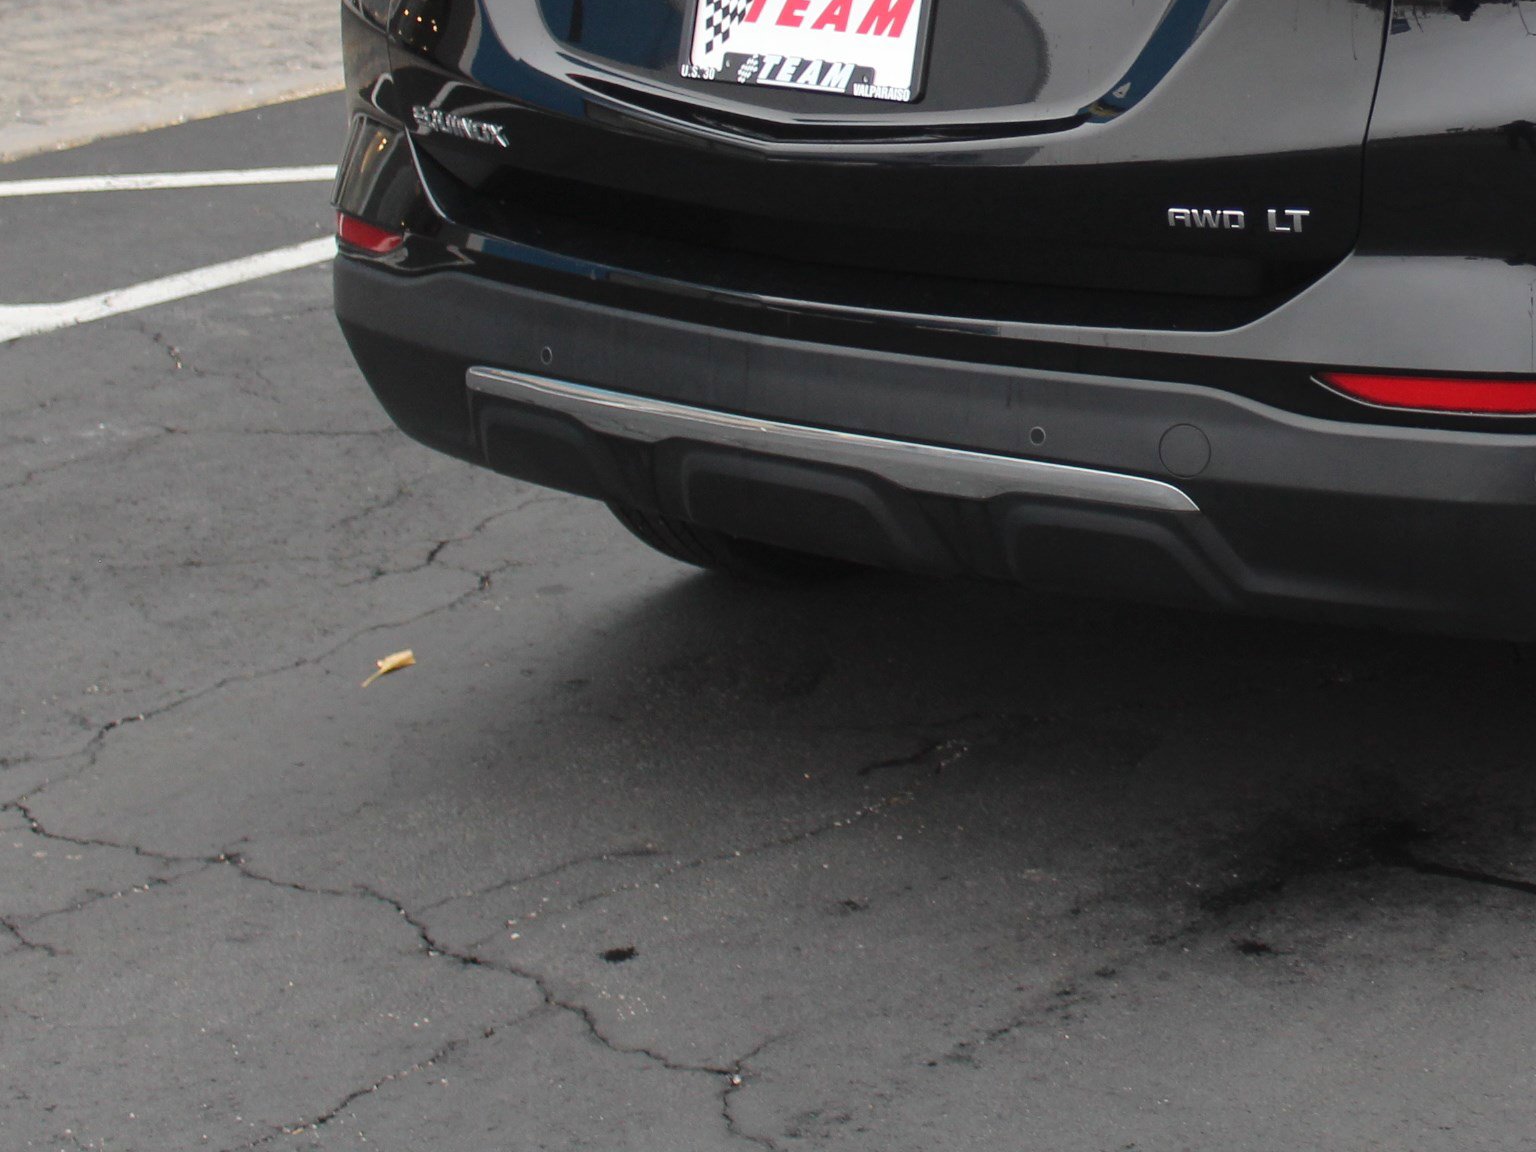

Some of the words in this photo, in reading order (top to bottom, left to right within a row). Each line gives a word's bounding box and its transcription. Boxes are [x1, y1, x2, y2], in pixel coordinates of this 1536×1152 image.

[757, 53, 855, 90] TEAM
[853, 82, 911, 103] VALPARAISO
[1167, 207, 1245, 230] AWD
[1266, 208, 1311, 233] LT
